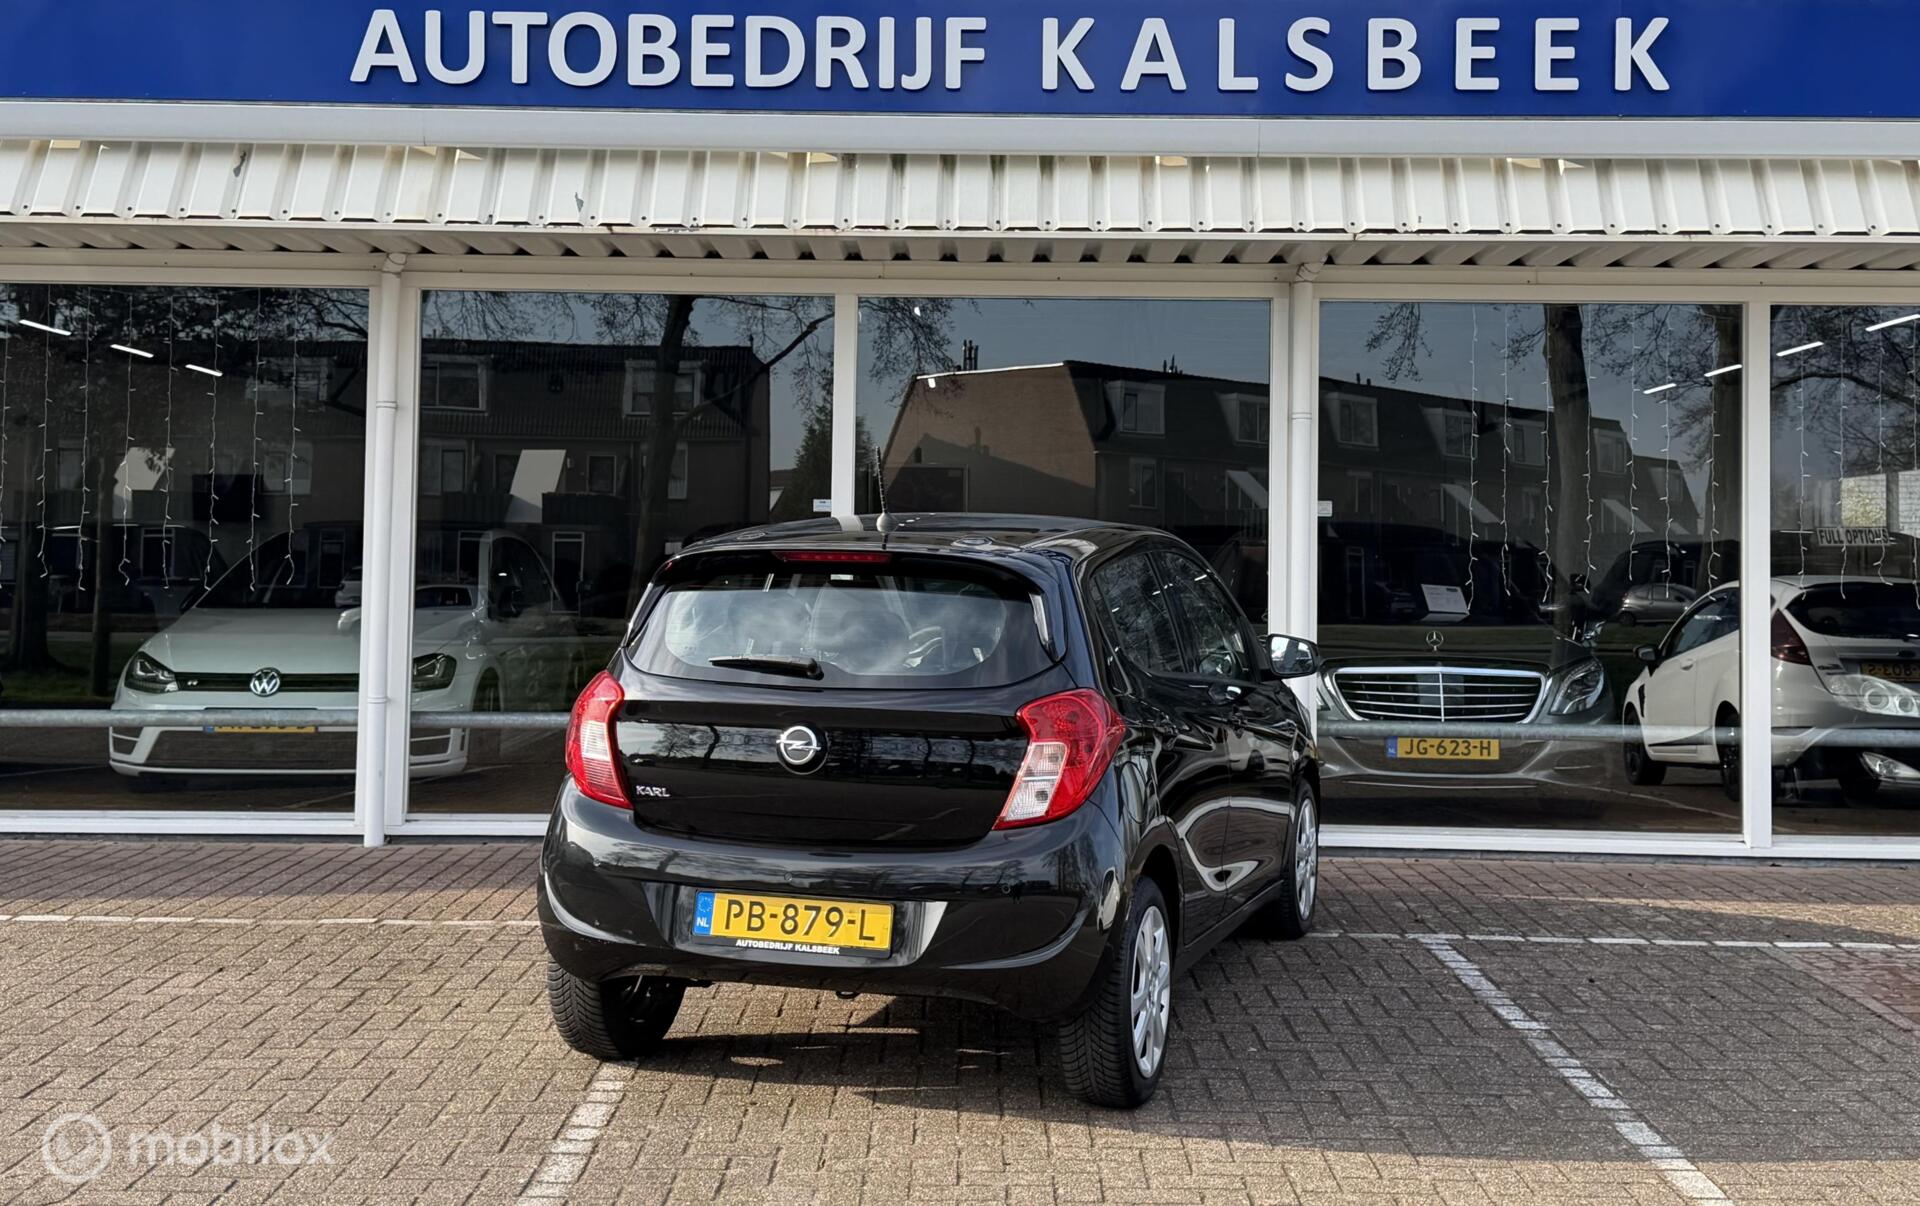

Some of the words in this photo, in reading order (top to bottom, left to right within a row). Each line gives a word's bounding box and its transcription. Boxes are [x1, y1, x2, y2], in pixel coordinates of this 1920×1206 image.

[349, 8, 988, 92] AUTOBEDRIJF
[1041, 16, 1671, 92] KALSBEEK
[1818, 529, 1844, 545] FULL
[1845, 529, 1889, 545] OPTIONS
[1404, 738, 1492, 757] JG-623-H
[636, 785, 670, 797] KARL
[696, 917, 709, 928] NL
[724, 899, 876, 942] PB-879-L
[735, 938, 793, 952] AUTOBEDRIJF
[795, 943, 840, 955] KALSBEEK
